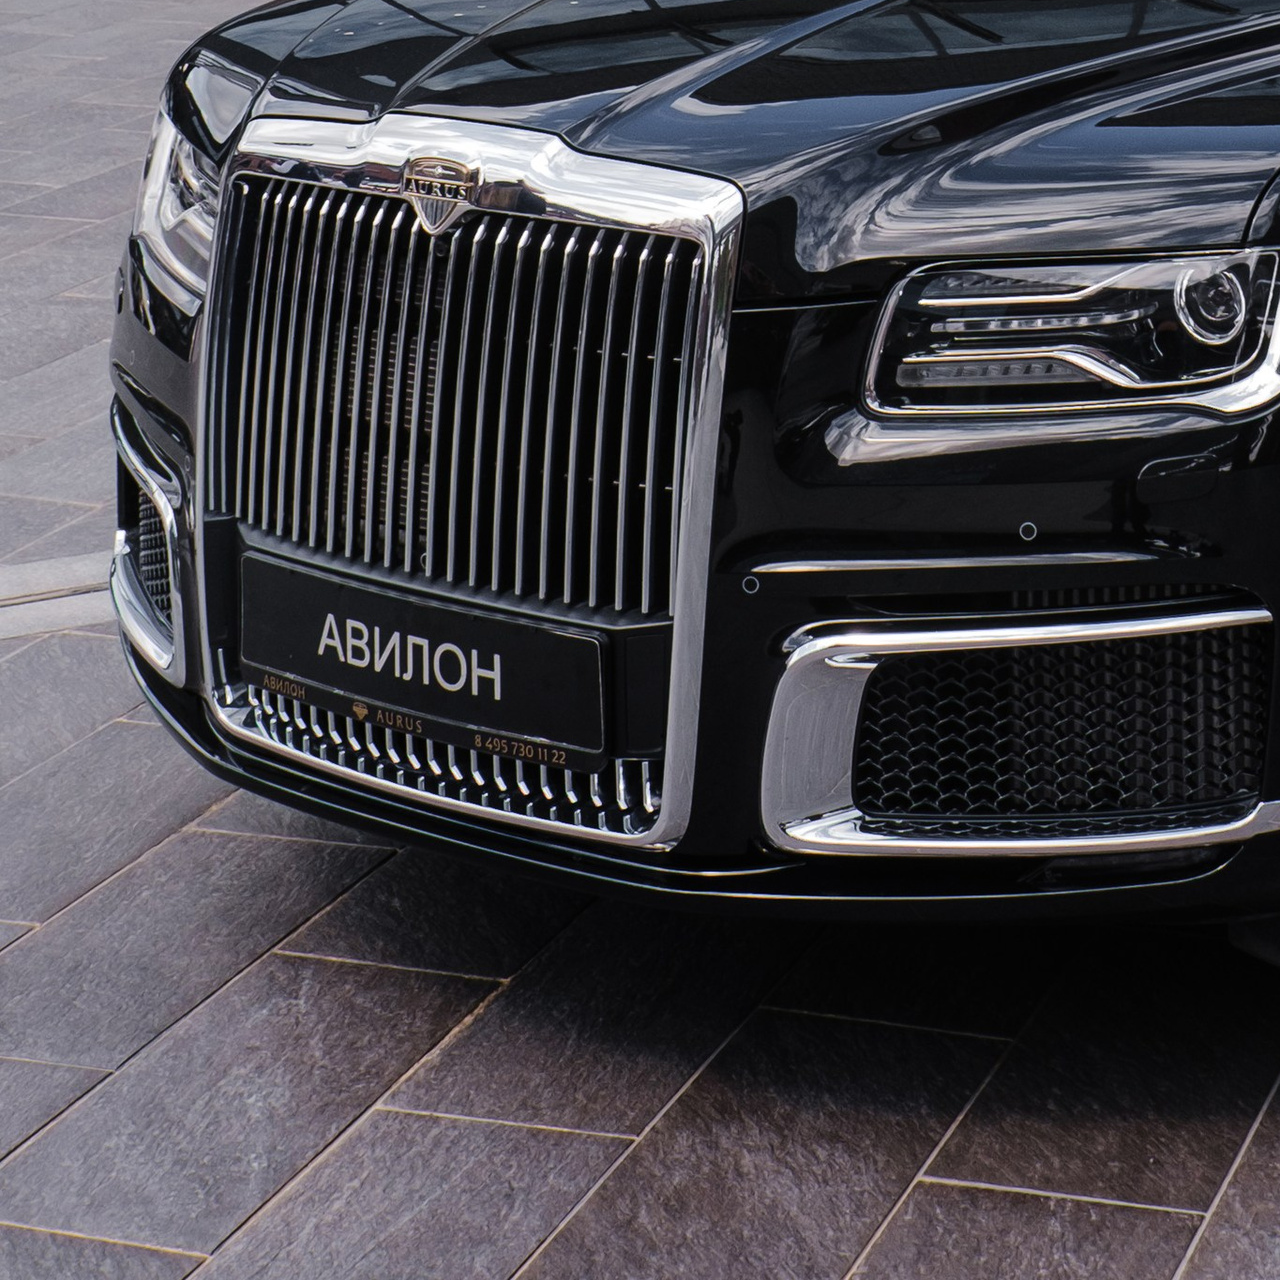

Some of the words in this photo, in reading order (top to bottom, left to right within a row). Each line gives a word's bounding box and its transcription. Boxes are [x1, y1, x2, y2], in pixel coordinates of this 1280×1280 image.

[408, 178, 467, 200] AURUS
[318, 613, 501, 701] АВИЛОН
[263, 674, 306, 700] АВИЛОН
[376, 710, 422, 734] AURUS
[474, 734, 483, 748] 8
[485, 737, 508, 754] 495
[511, 742, 535, 759] 730
[538, 747, 548, 762] 11
[551, 749, 567, 765] 22
